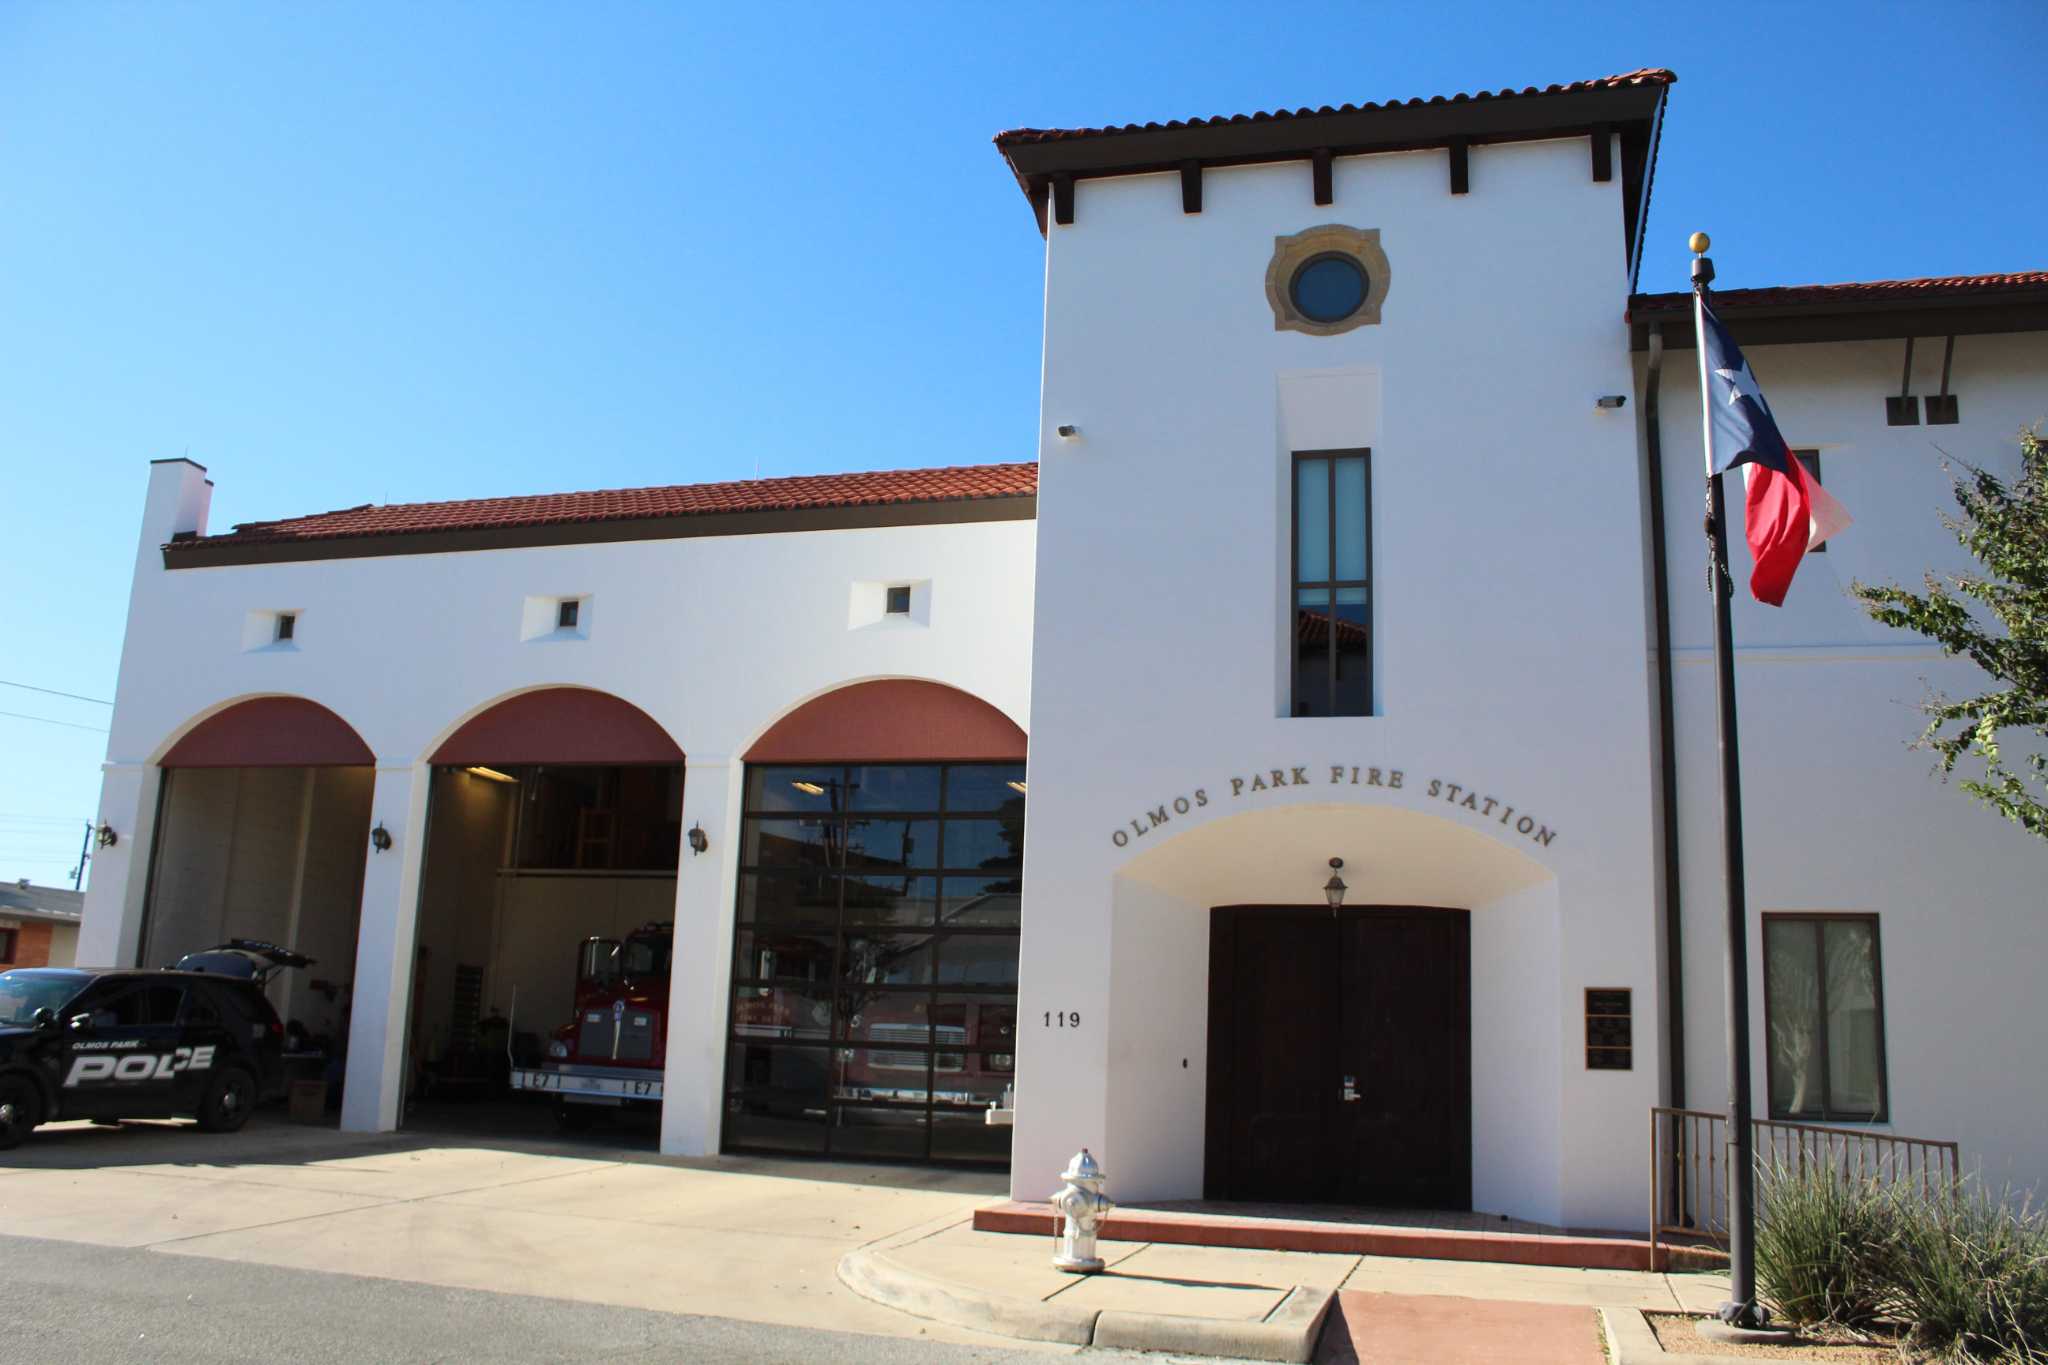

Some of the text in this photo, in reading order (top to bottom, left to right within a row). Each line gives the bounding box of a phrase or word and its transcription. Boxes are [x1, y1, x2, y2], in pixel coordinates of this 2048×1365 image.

[1112, 766, 1557, 847] OLMOS PARK FIRE STATION
[1043, 1010, 1080, 1028] 119
[72, 1041, 109, 1051] OLMOS
[62, 1044, 216, 1088] POLCE
